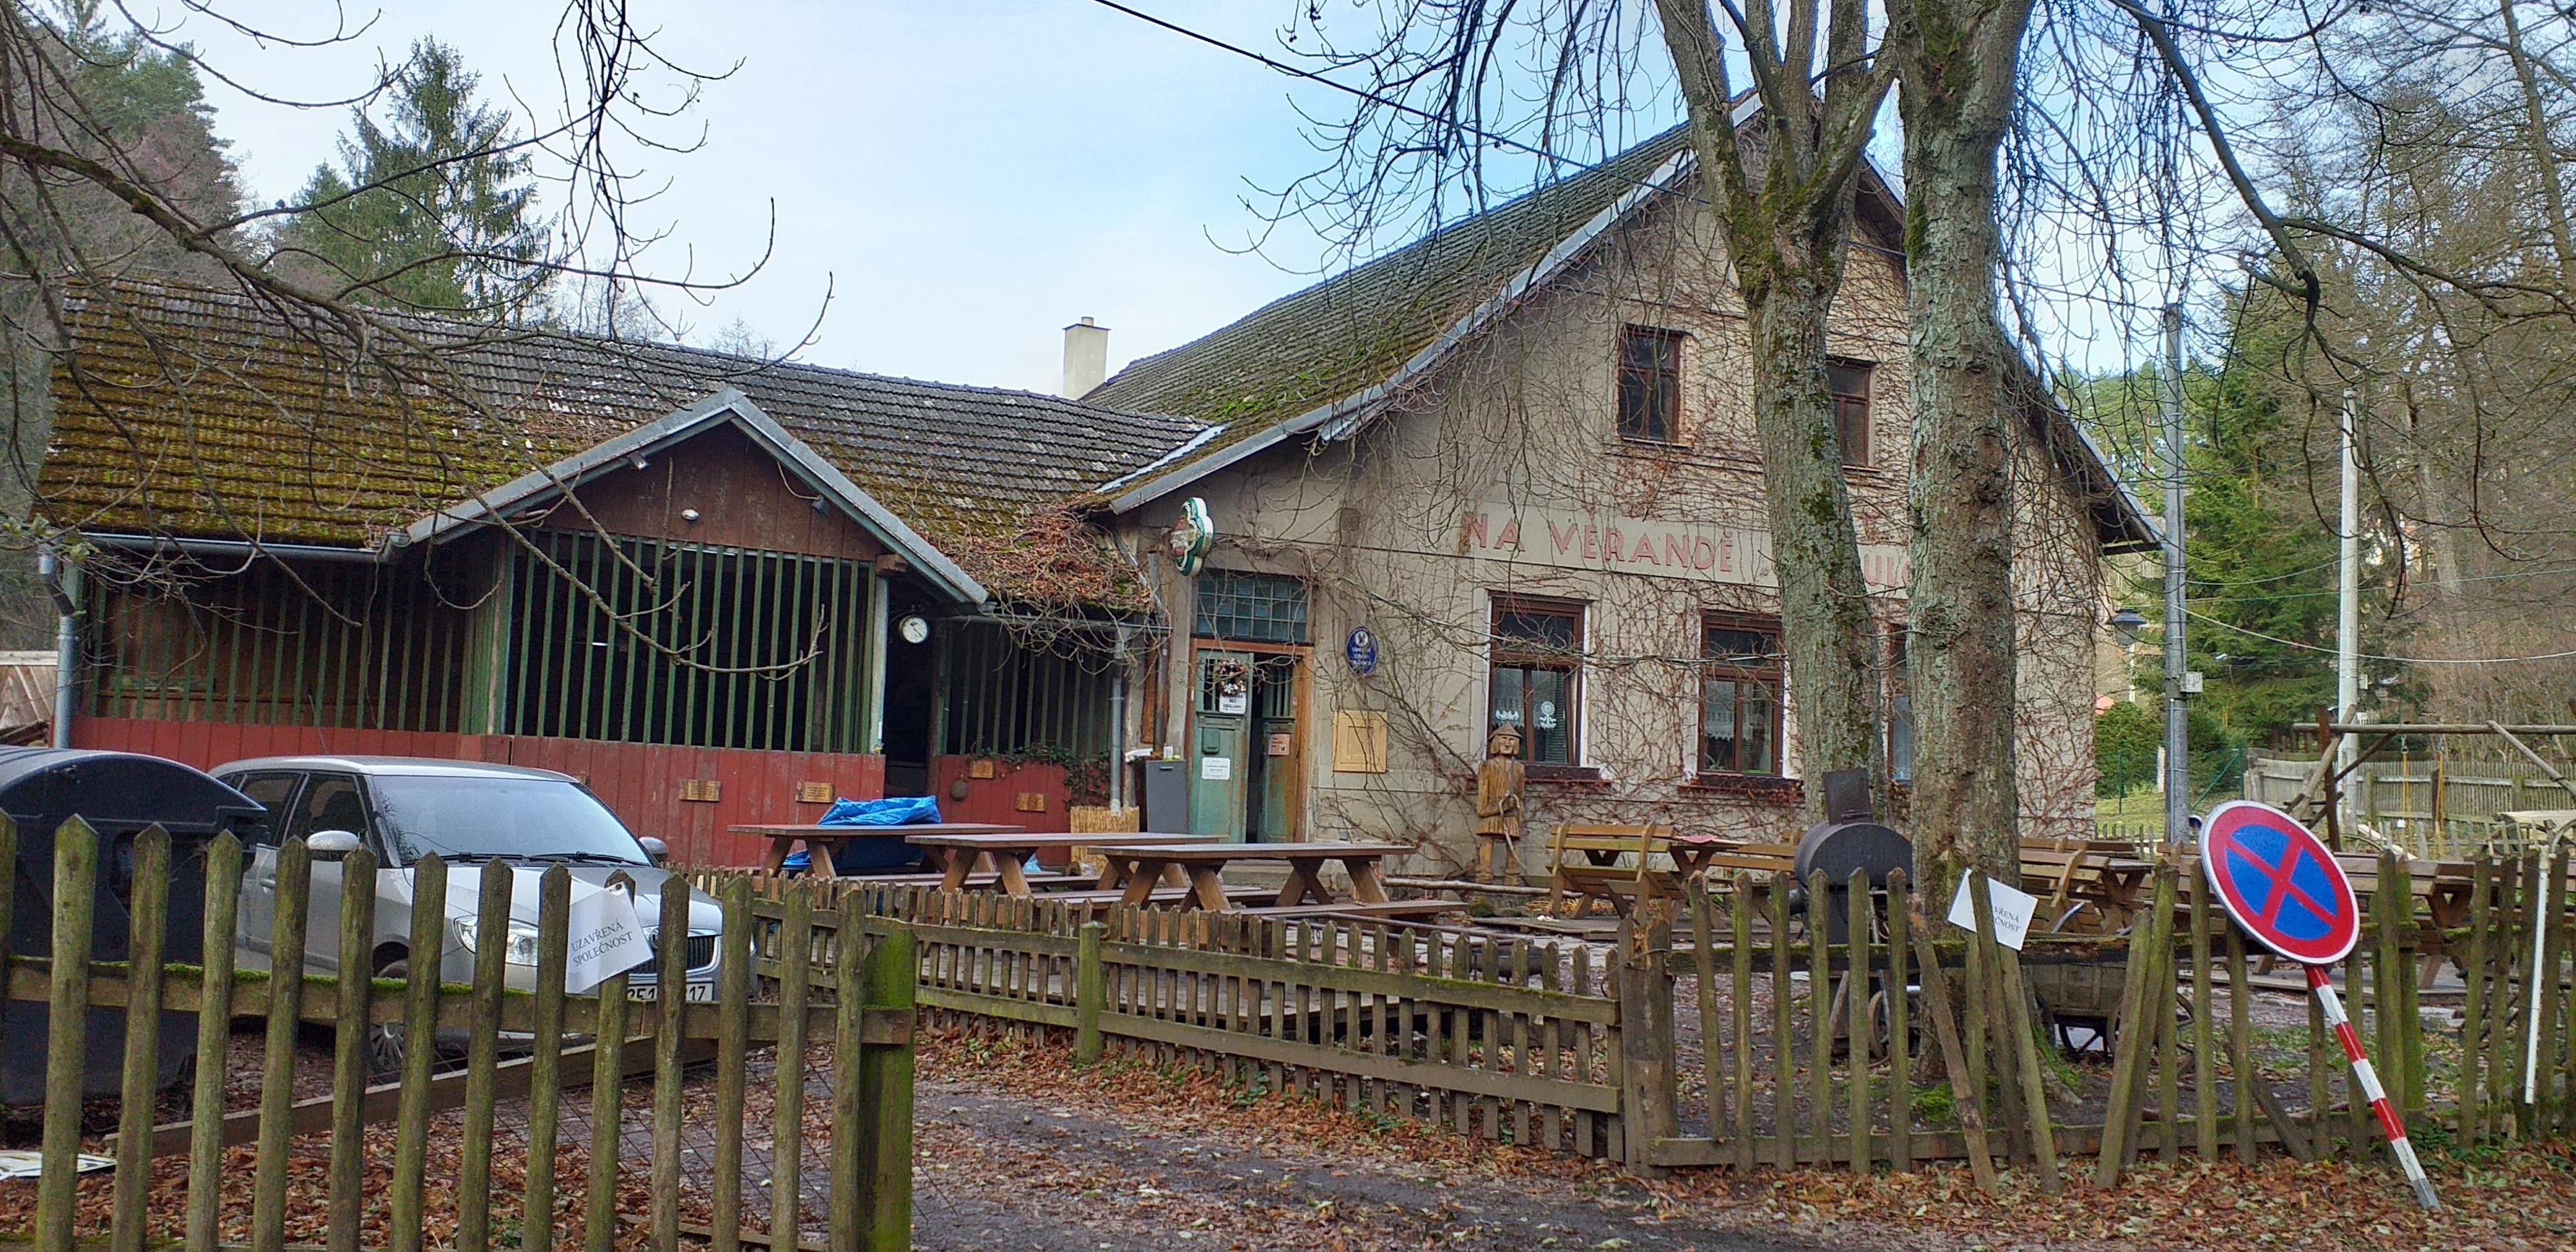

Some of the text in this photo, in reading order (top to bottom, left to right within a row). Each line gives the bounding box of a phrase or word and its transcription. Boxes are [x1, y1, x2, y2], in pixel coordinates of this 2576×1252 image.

[1461, 513, 1526, 552] NA
[1547, 520, 1732, 572] VERANDĚ
[1994, 906, 2019, 923] VŘENÁ
[1994, 915, 2022, 932] ČNOST
[571, 918, 624, 952] UZAVŘENÁ
[573, 931, 633, 967] SPOLEČNOST
